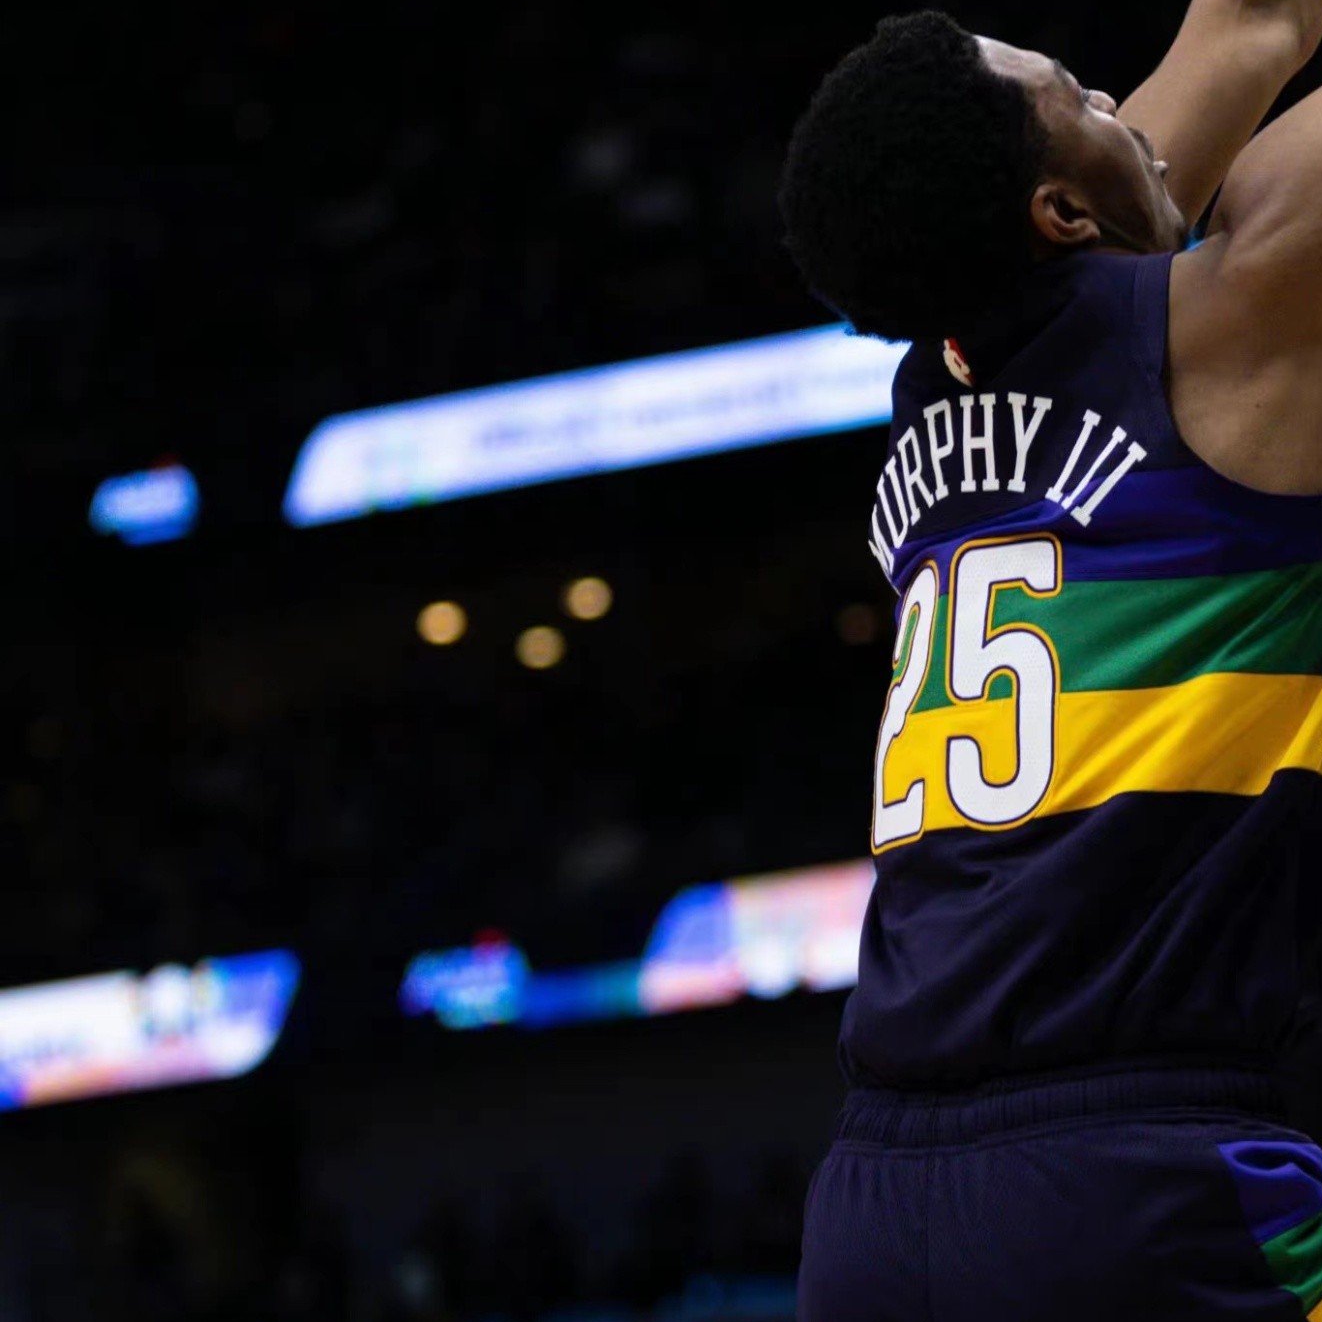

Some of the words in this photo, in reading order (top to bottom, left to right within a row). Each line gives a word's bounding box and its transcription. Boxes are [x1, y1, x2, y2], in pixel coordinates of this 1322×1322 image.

[867, 391, 1053, 584] MURPHY
[1045, 408, 1147, 528] III
[871, 531, 1063, 855] 25
